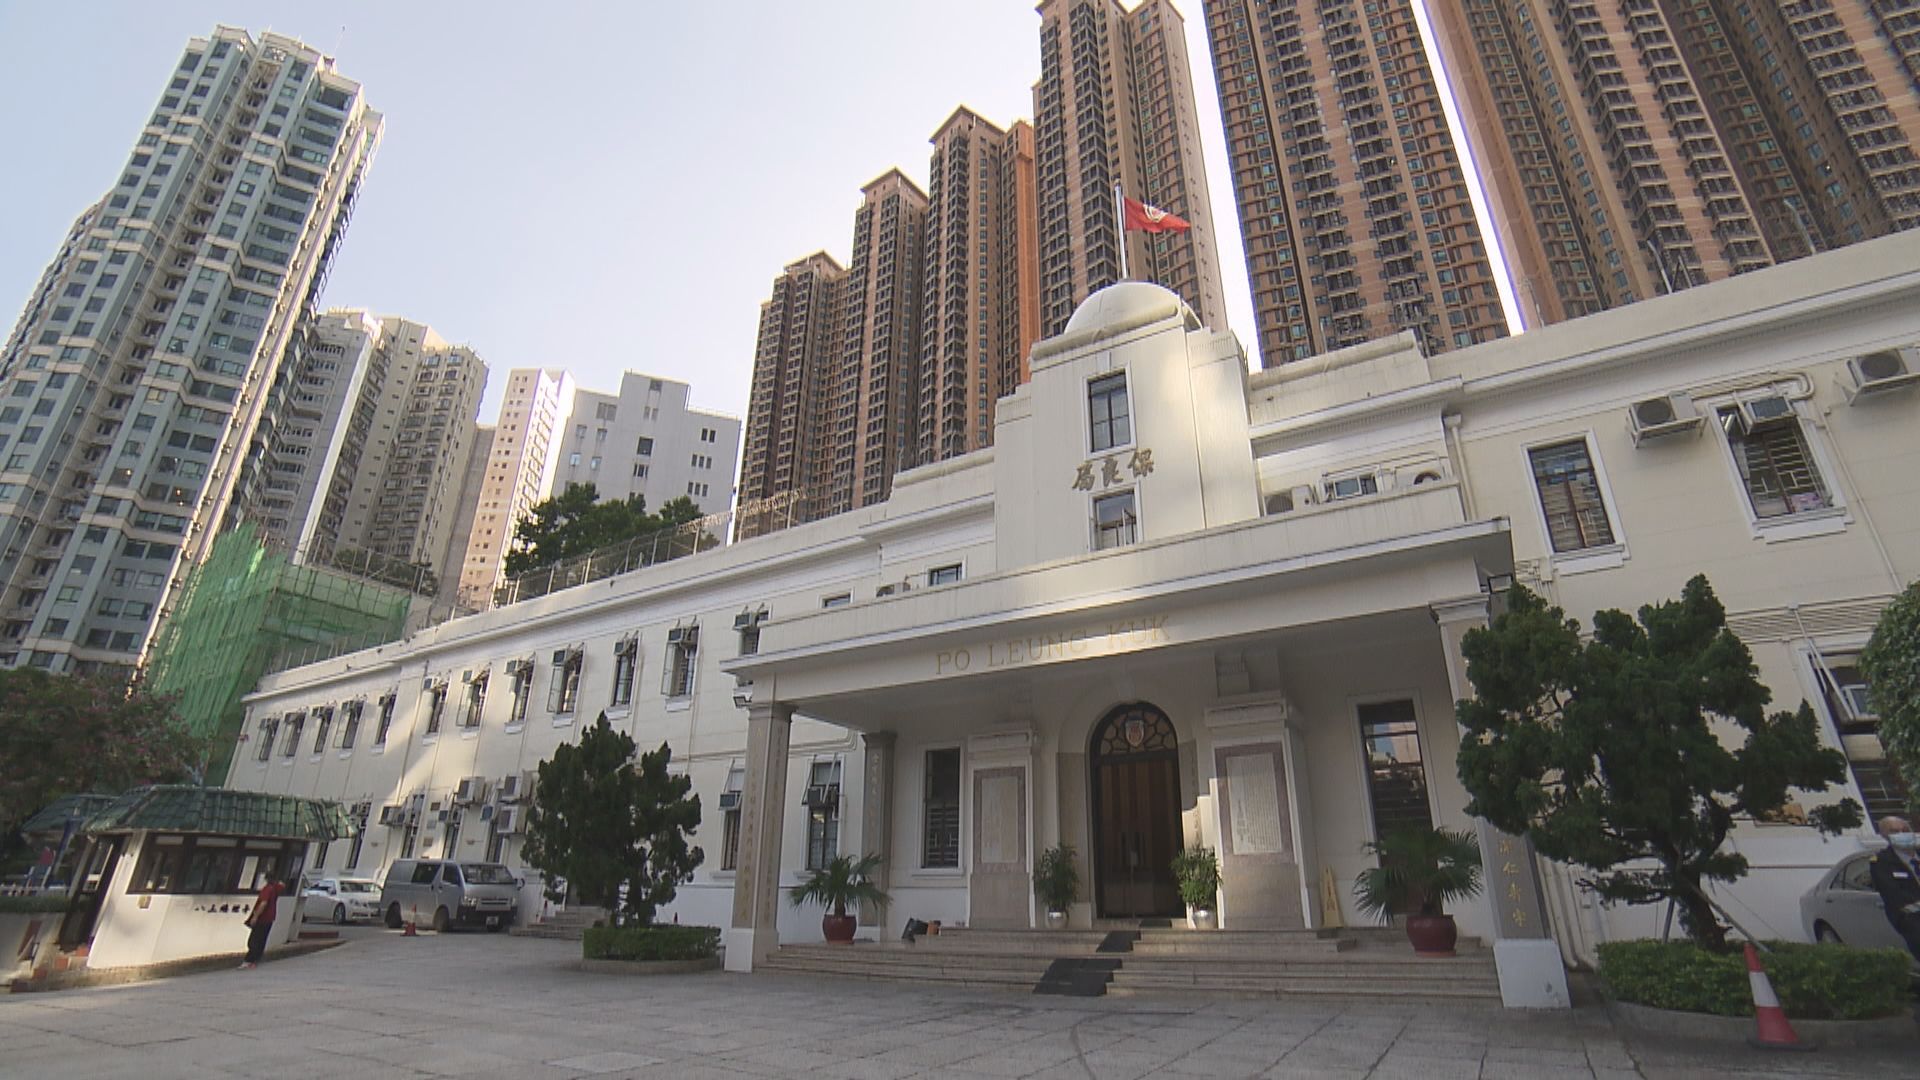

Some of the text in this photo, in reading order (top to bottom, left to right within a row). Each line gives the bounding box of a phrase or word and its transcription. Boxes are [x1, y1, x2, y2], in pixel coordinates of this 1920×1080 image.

[935, 616, 1170, 675] PO LEUNG KUK
